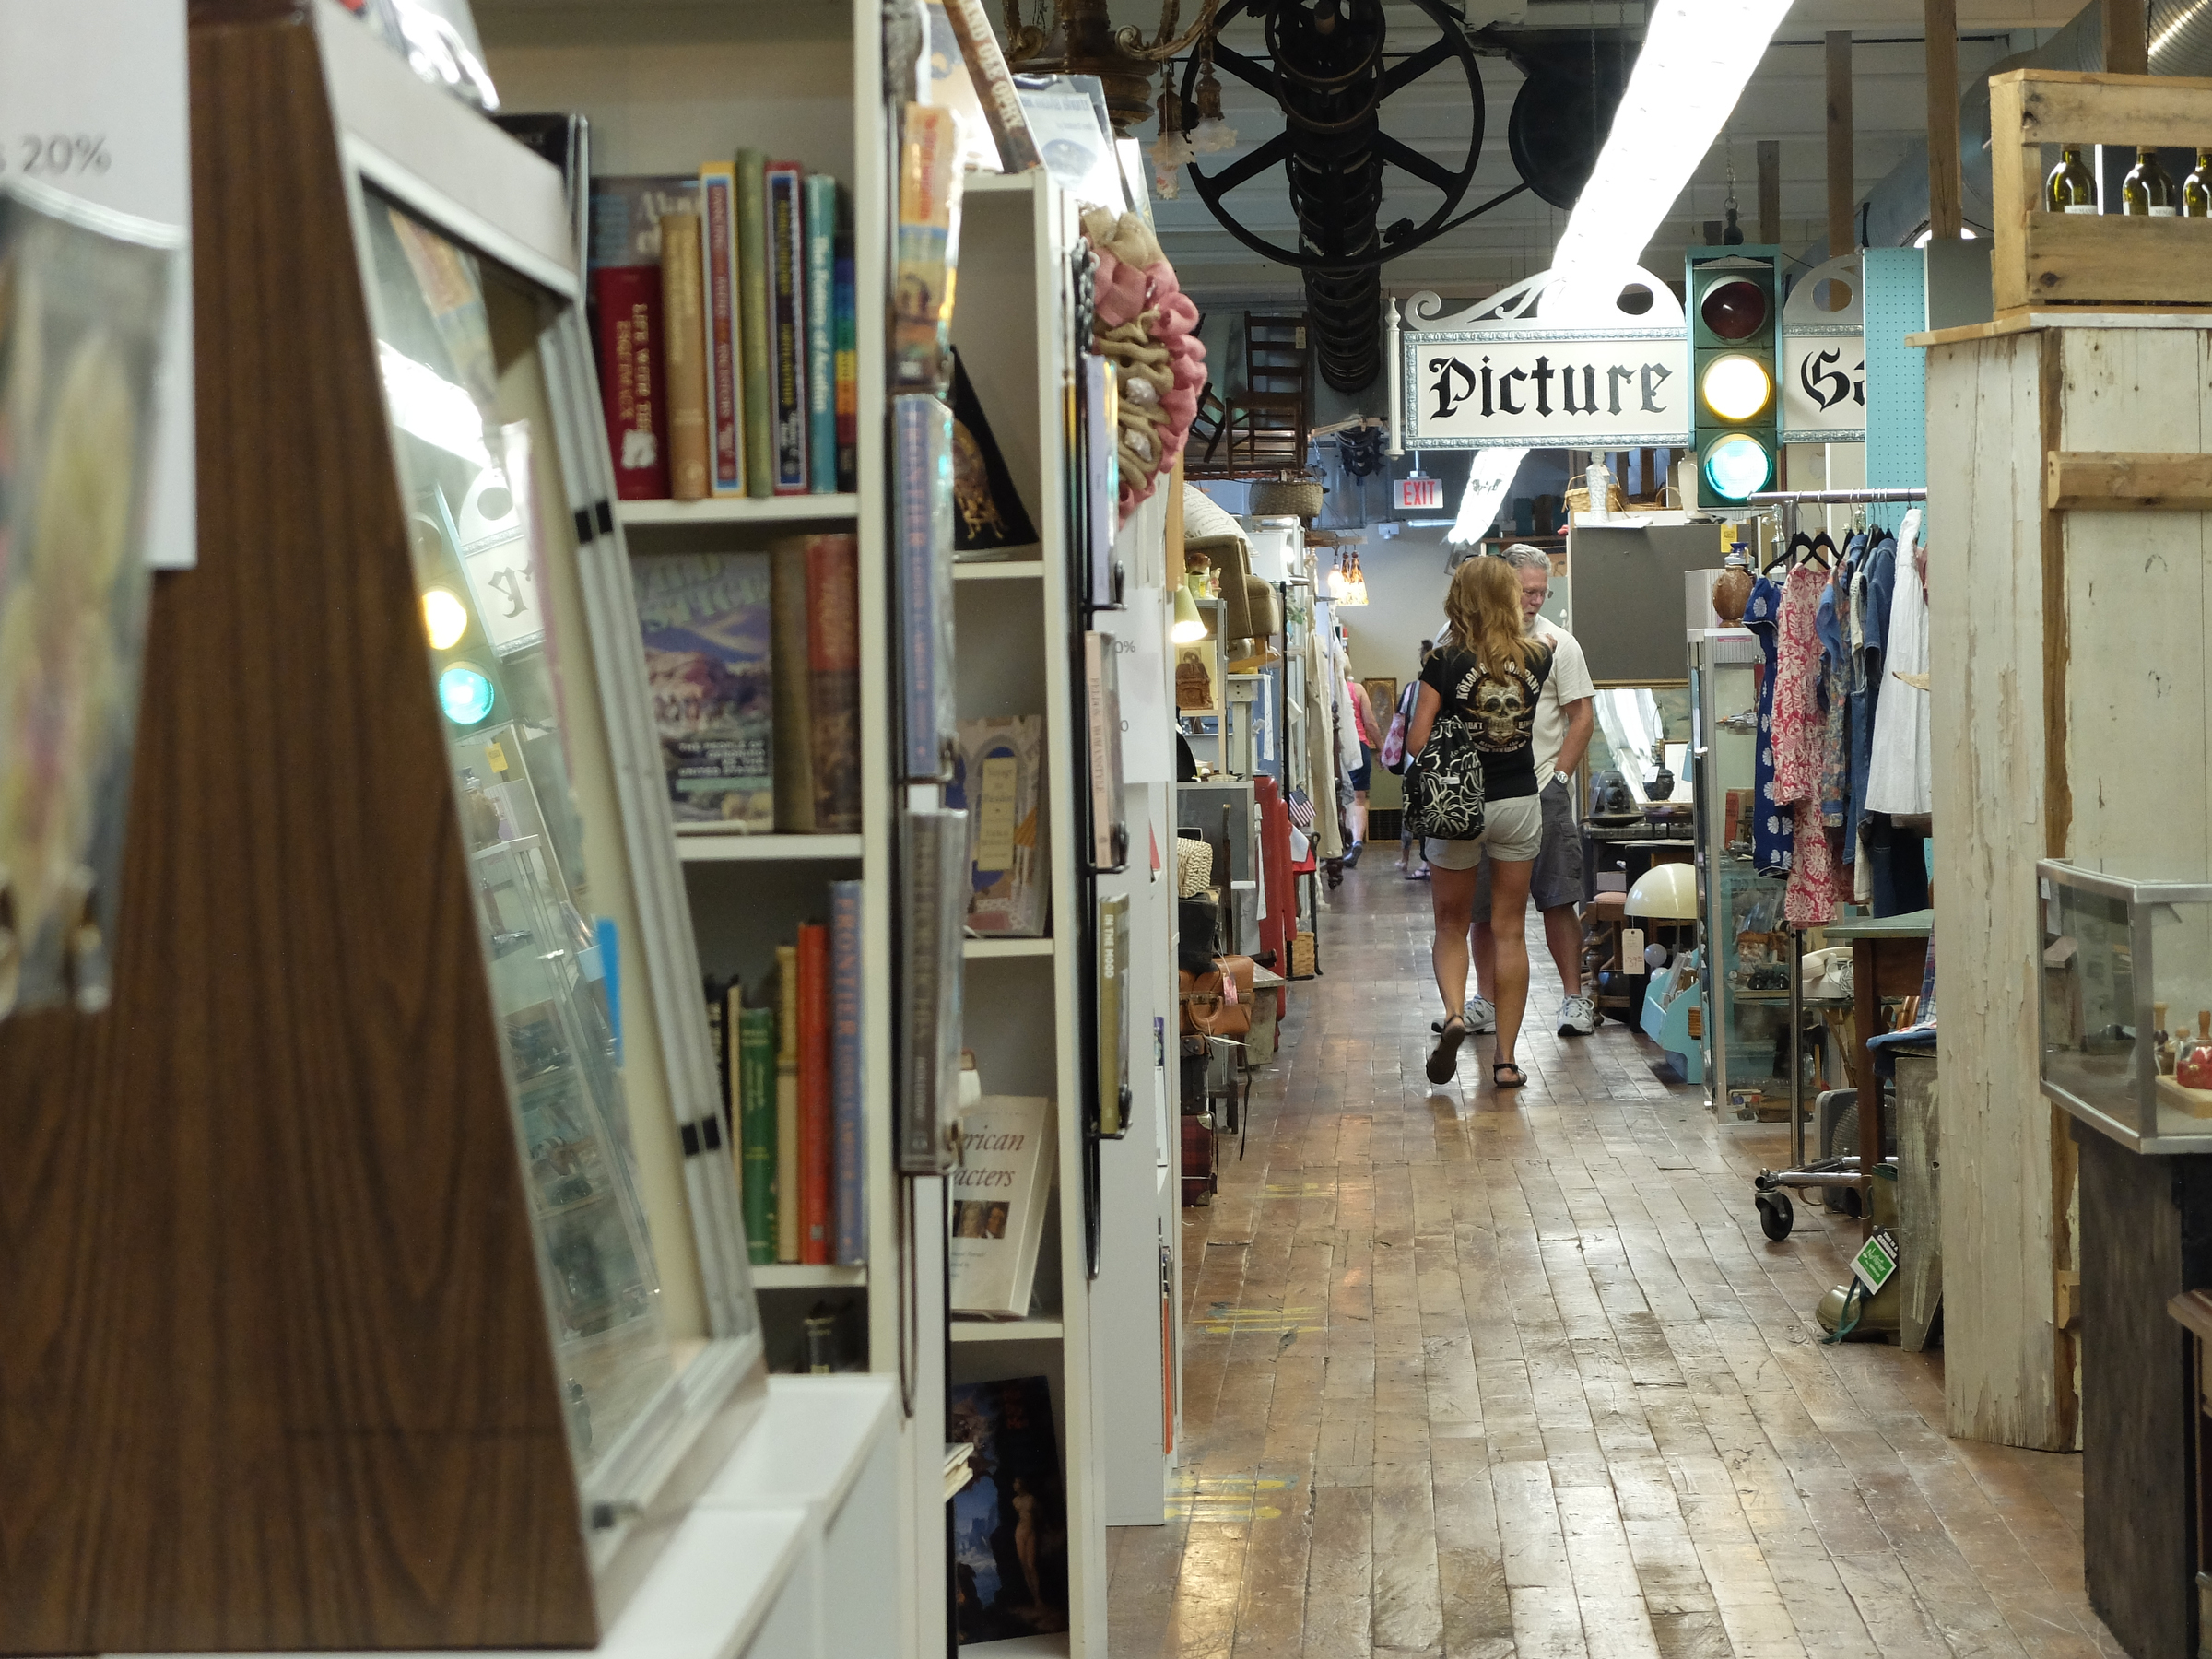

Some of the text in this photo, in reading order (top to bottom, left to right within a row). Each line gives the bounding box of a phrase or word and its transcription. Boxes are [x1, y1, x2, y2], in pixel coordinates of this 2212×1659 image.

[992, 81, 1027, 131] OPRY
[20, 134, 112, 175] 20%
[634, 348, 651, 396] WITH
[1429, 354, 1673, 420] Picture
[1403, 480, 1435, 506] EXIT
[1114, 640, 1136, 654] 0%
[1104, 913, 1114, 979] IN THE MOOD
[835, 897, 858, 1036] FRONTIER
[963, 1126, 1025, 1152] rican
[954, 1169, 1016, 1188] acters
[1877, 1234, 1898, 1259] GENUINE
[1883, 1231, 1892, 1242] THIS
